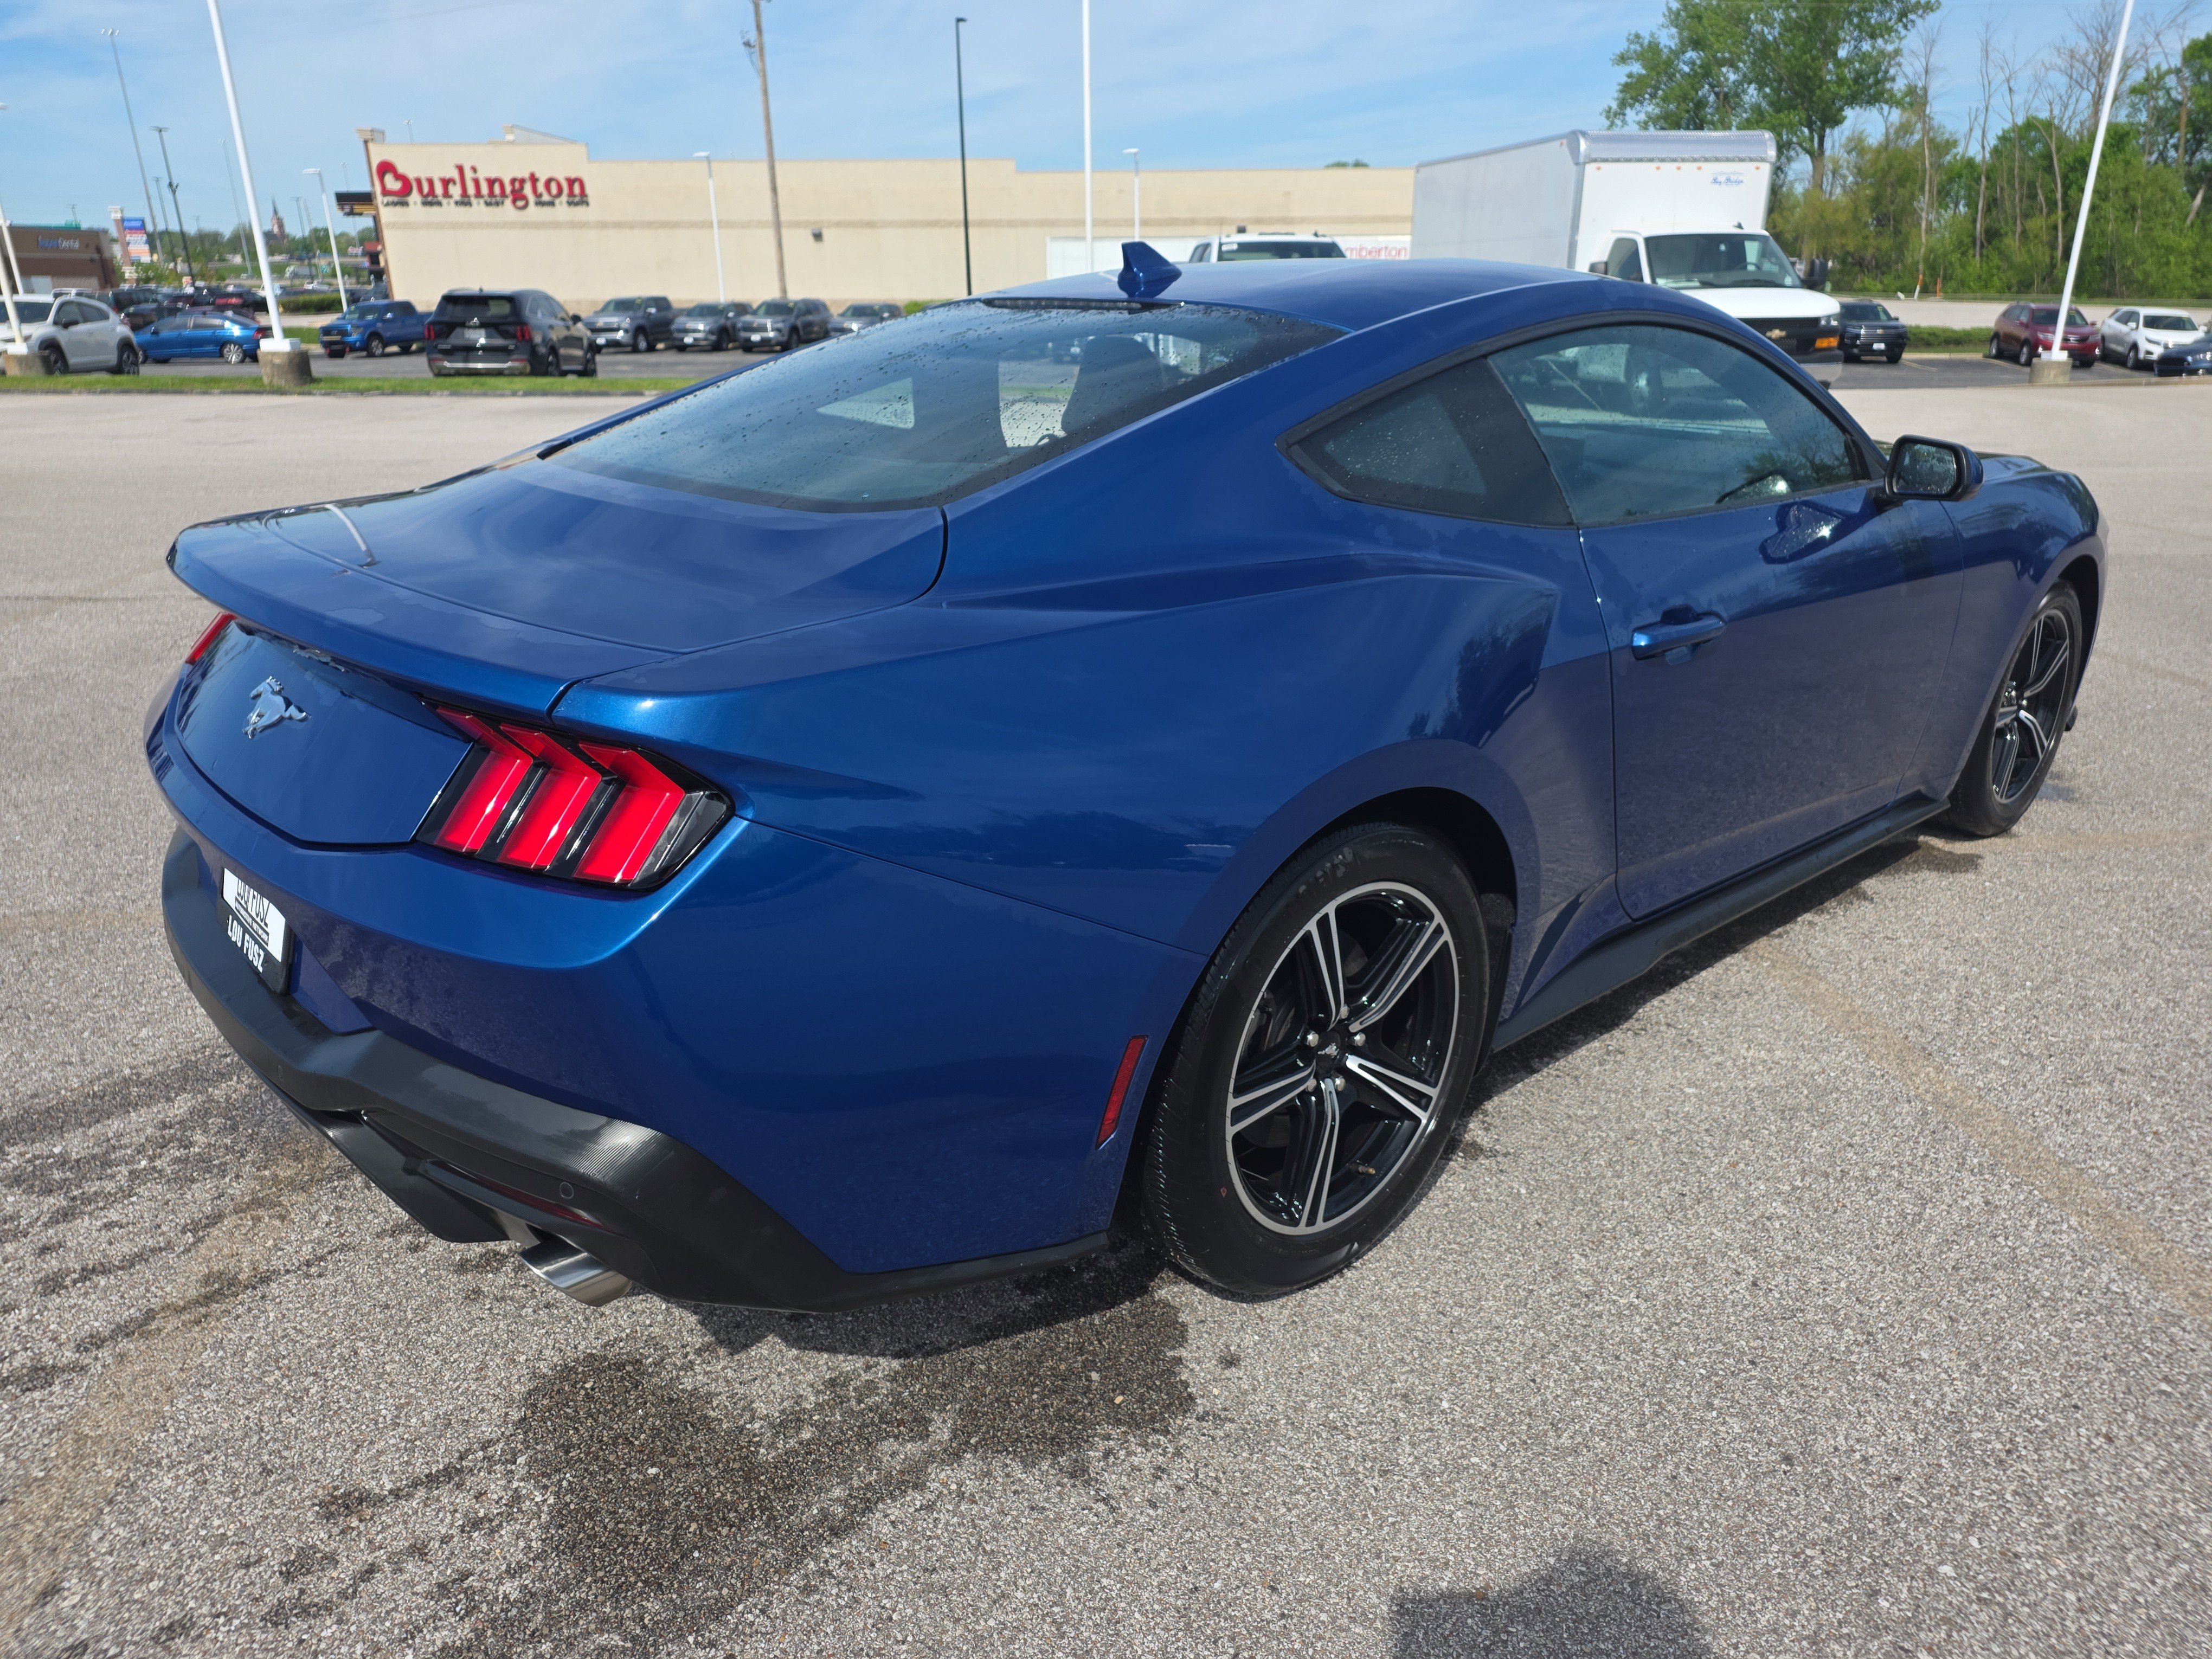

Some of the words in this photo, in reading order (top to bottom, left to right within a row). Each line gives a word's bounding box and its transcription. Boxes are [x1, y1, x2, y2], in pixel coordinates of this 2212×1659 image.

[375, 159, 589, 210] Burlington
[228, 915, 242, 948] LOU
[244, 933, 264, 973] FUSZ
